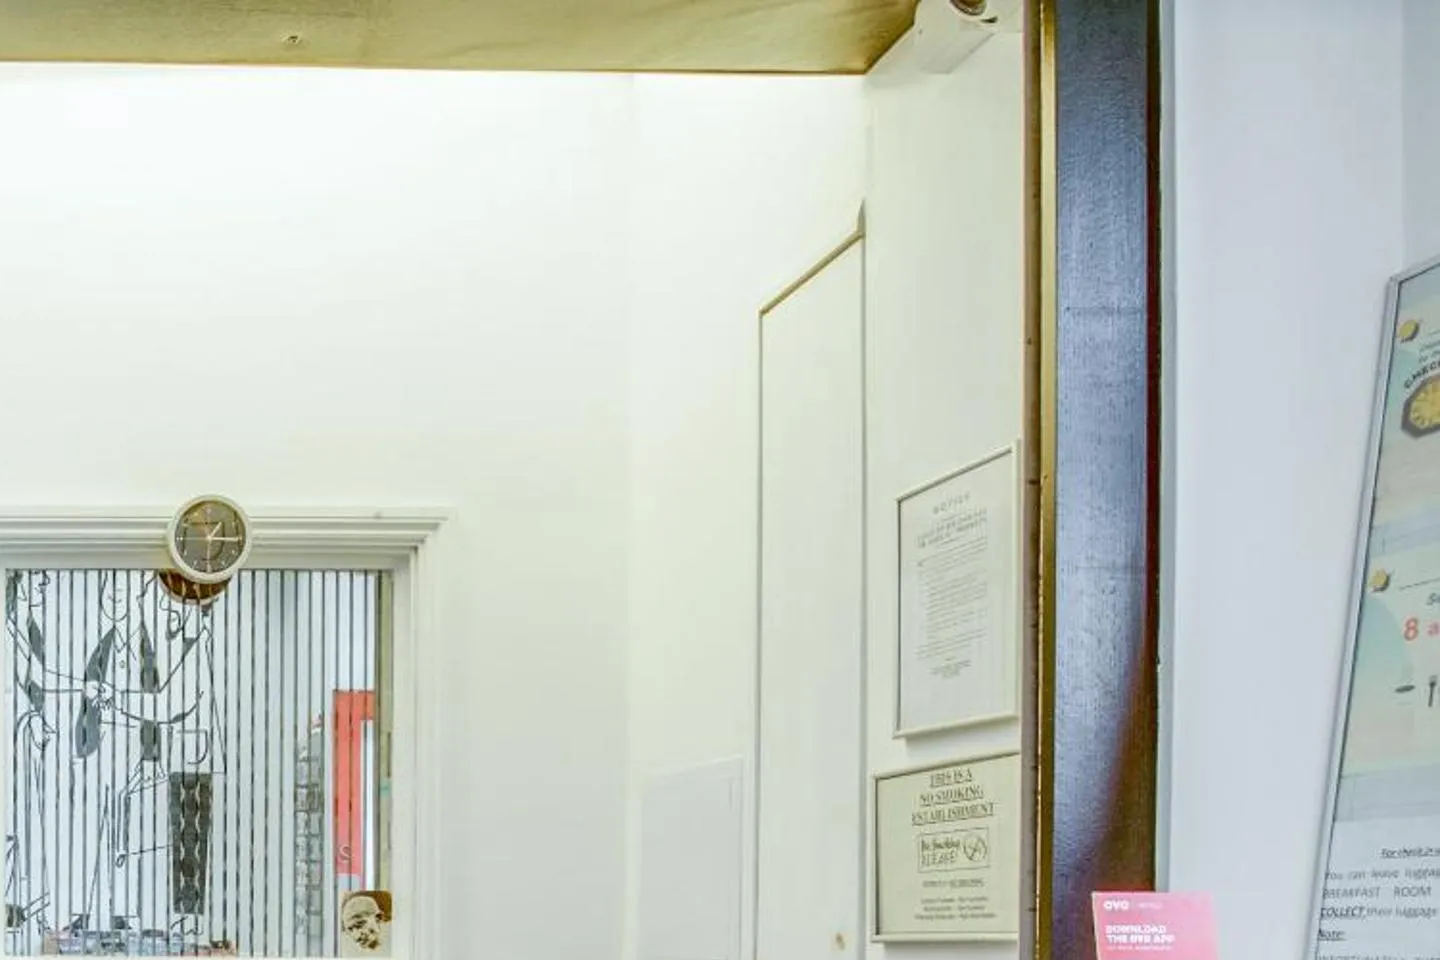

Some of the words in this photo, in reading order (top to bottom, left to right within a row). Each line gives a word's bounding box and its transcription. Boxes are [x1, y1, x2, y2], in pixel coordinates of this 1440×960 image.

[1403, 617, 1419, 642] 8
[1394, 885, 1432, 898] ROOM
[1105, 924, 1167, 934] DOWNLOAD
[1106, 934, 1129, 943] THE
[1153, 934, 1176, 943] APP
